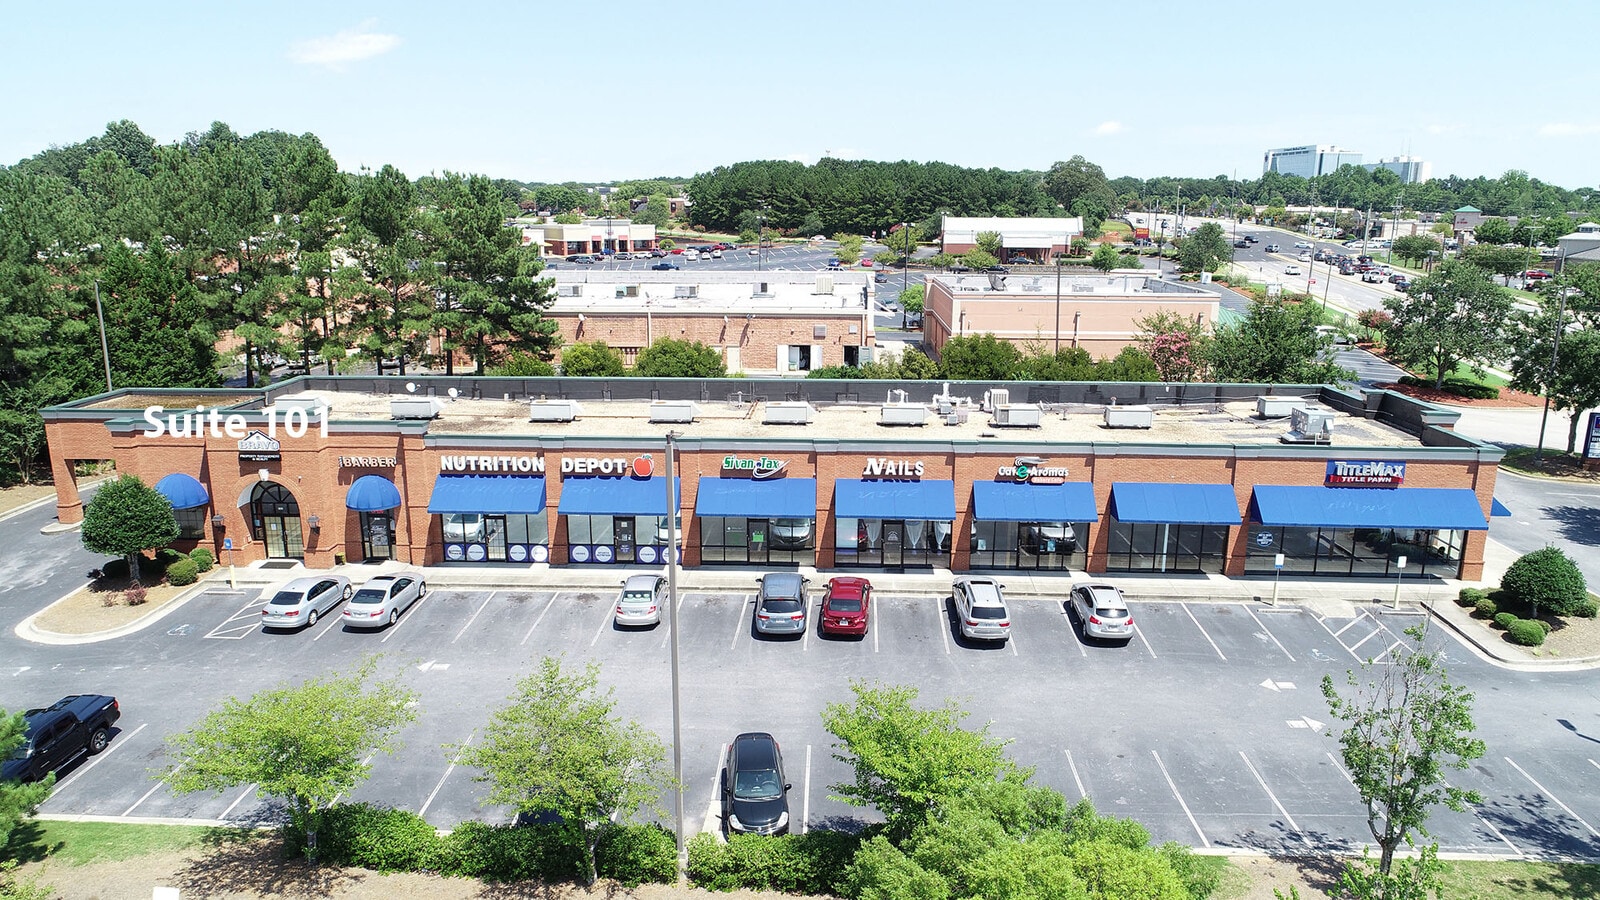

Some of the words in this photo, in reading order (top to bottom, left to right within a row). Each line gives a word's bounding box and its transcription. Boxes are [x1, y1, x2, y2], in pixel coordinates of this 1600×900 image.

[240, 441, 279, 450] BRAVO
[343, 457, 397, 468] BARBER
[441, 456, 545, 472] NUTRITION
[561, 457, 627, 473] DEPOT
[723, 455, 754, 469] Sivan
[761, 456, 779, 469] Tax
[863, 458, 925, 476] NAILS
[1030, 466, 1069, 476] Aromas
